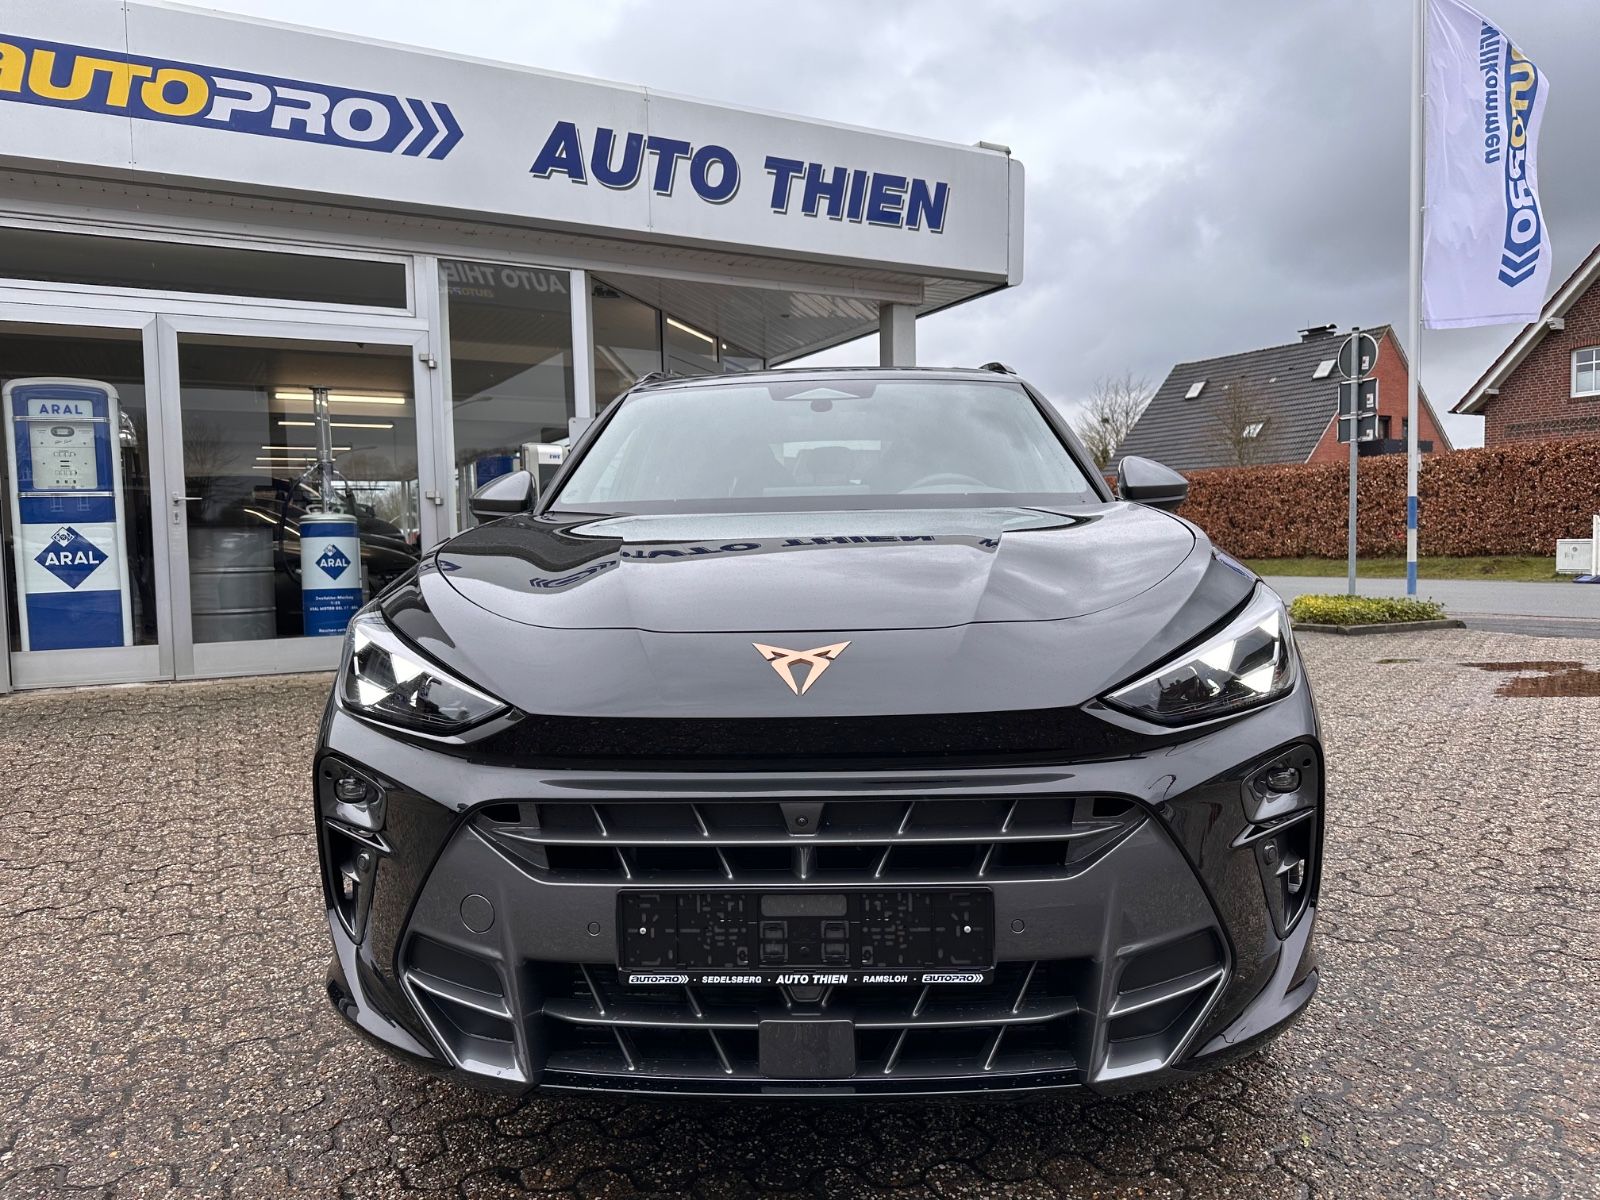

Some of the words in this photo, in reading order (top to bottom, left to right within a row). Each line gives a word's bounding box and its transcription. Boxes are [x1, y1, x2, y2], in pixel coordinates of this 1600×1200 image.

[529, 120, 741, 206] AUTO
[764, 155, 951, 235] THIEN
[39, 403, 83, 415] ARAL
[45, 551, 100, 566] ARAL
[320, 558, 348, 568] ARAL
[701, 975, 762, 984] SEDELSBERG
[775, 974, 809, 985] AUTO
[812, 974, 848, 984] THIEN
[862, 975, 908, 983] RAMSLOH
